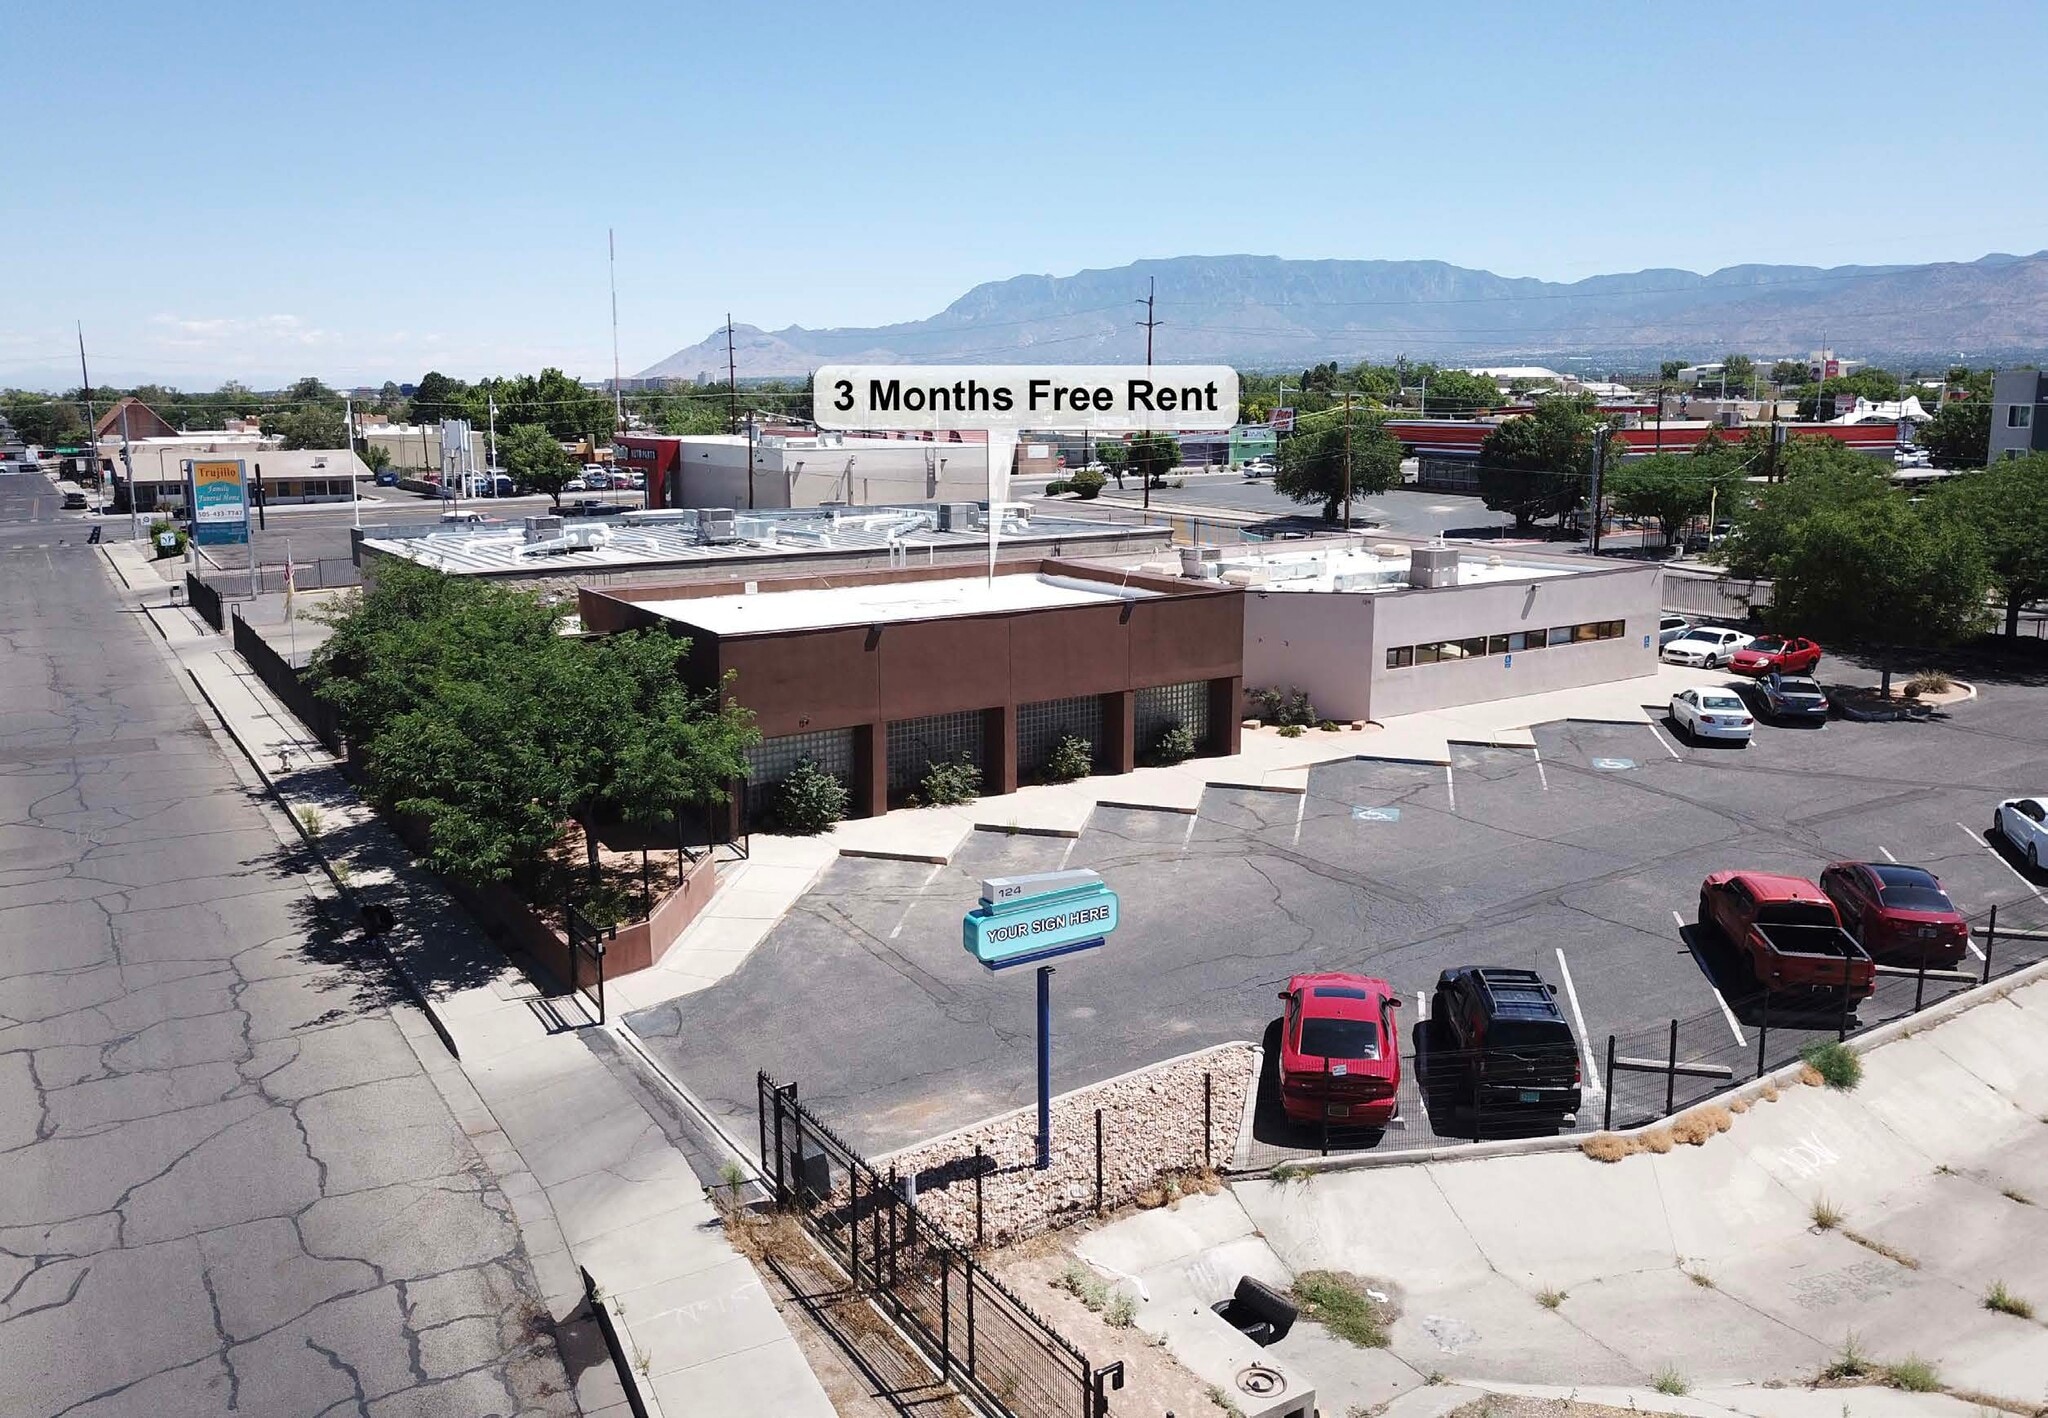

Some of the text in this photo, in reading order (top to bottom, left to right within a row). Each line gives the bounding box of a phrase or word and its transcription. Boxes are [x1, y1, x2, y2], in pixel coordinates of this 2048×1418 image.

[200, 468, 236, 478] Trujillo
[998, 885, 1022, 898] 124
[987, 905, 1110, 944] YOUR SIGN HERE
